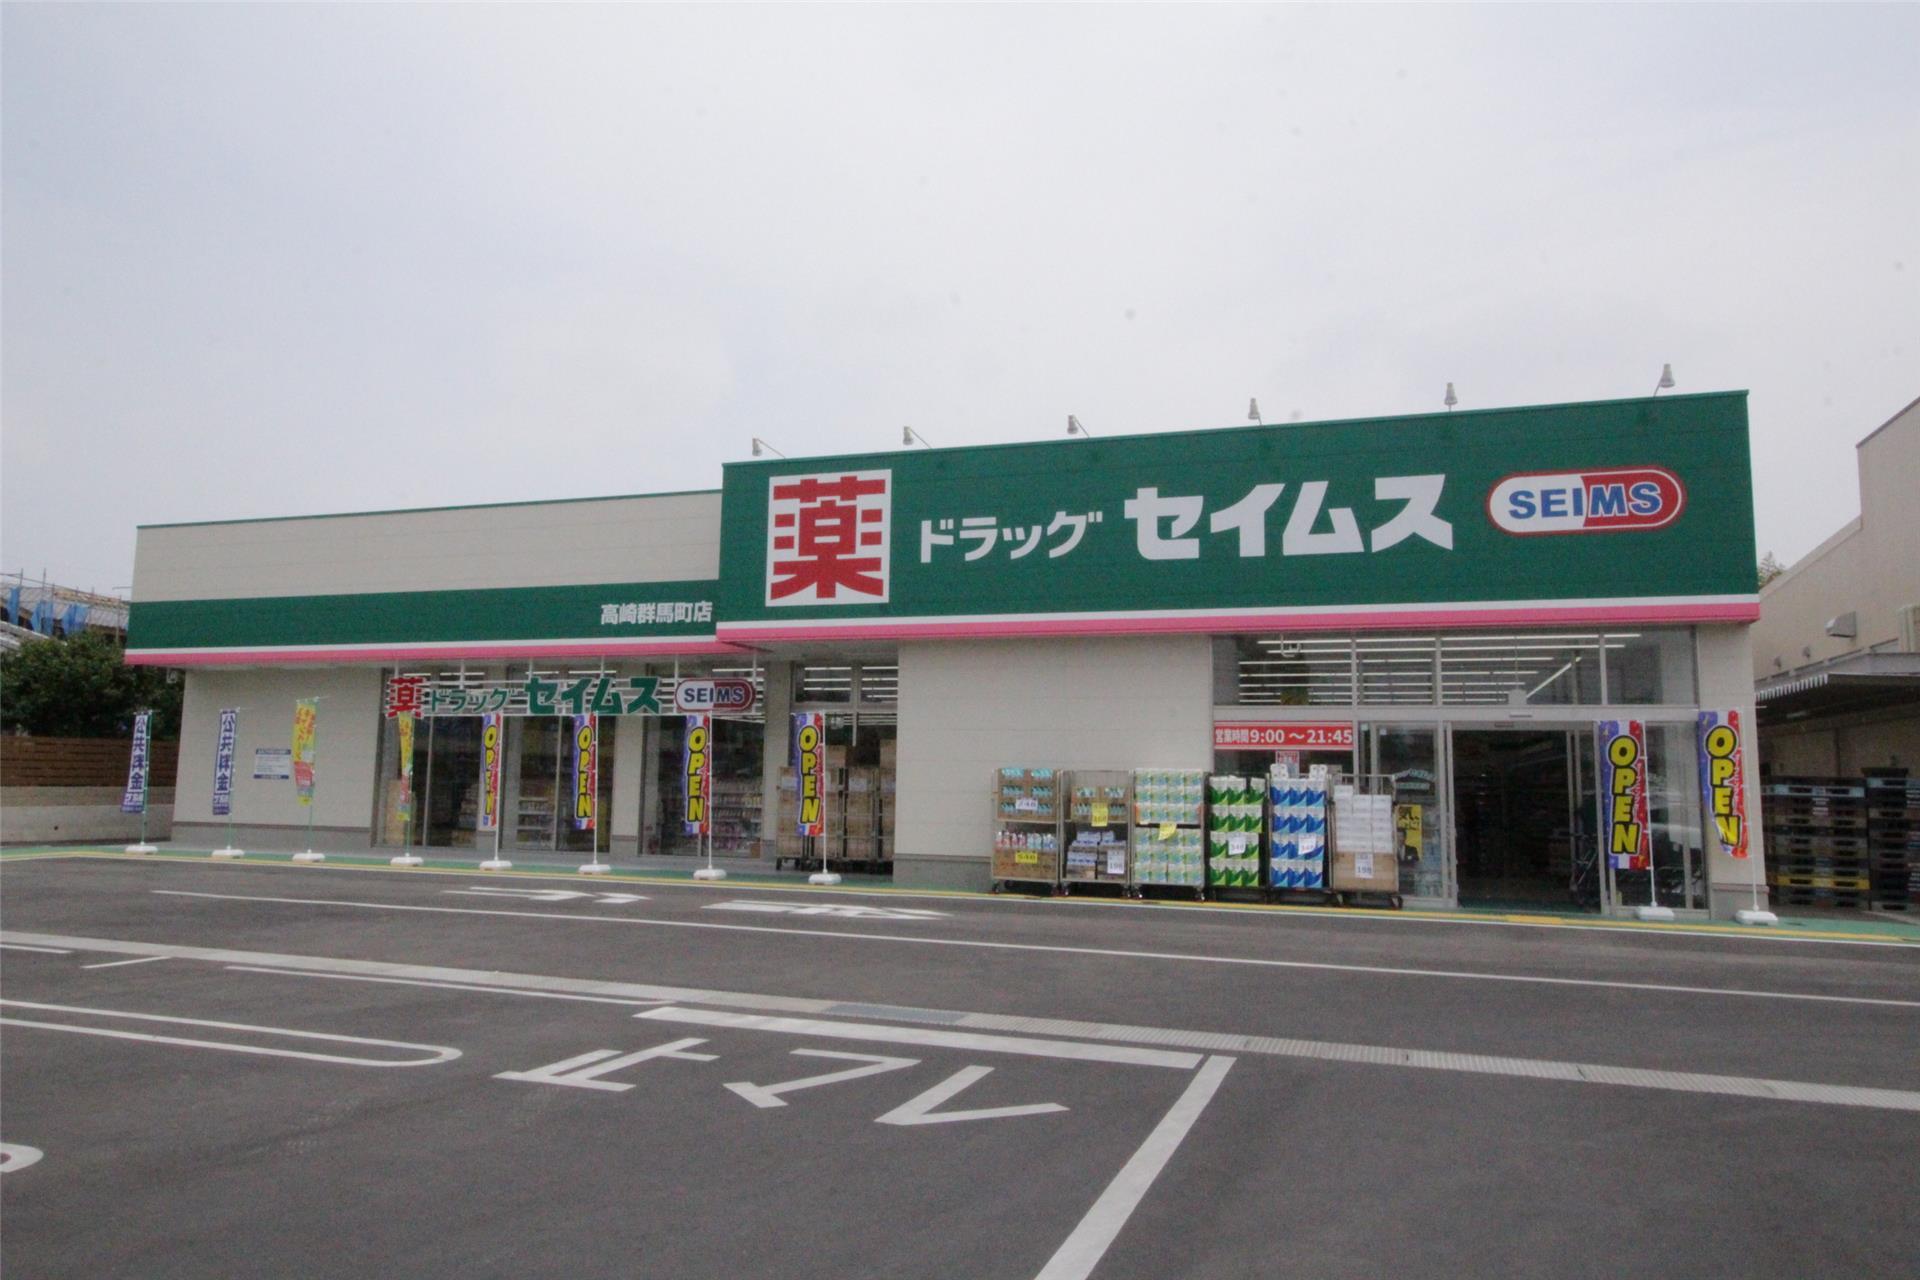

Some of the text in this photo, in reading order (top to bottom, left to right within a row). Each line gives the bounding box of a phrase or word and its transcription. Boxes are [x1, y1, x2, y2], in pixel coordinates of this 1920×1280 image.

[771, 476, 886, 599] 薬
[920, 472, 1455, 563] ドラッグ セイムス
[1507, 481, 1664, 521] SEIMS
[600, 600, 714, 626] 高崎群馬町店
[386, 676, 425, 718] 薬
[430, 676, 663, 715] ドラッグ セイムス
[683, 685, 745, 705] SEIMS
[483, 724, 498, 816] OPEN
[576, 726, 593, 819] OPEN
[687, 726, 708, 822] OPEN
[799, 725, 821, 824] OPEN
[1608, 735, 1640, 855] OPEN
[1705, 725, 1741, 846] OPEN
